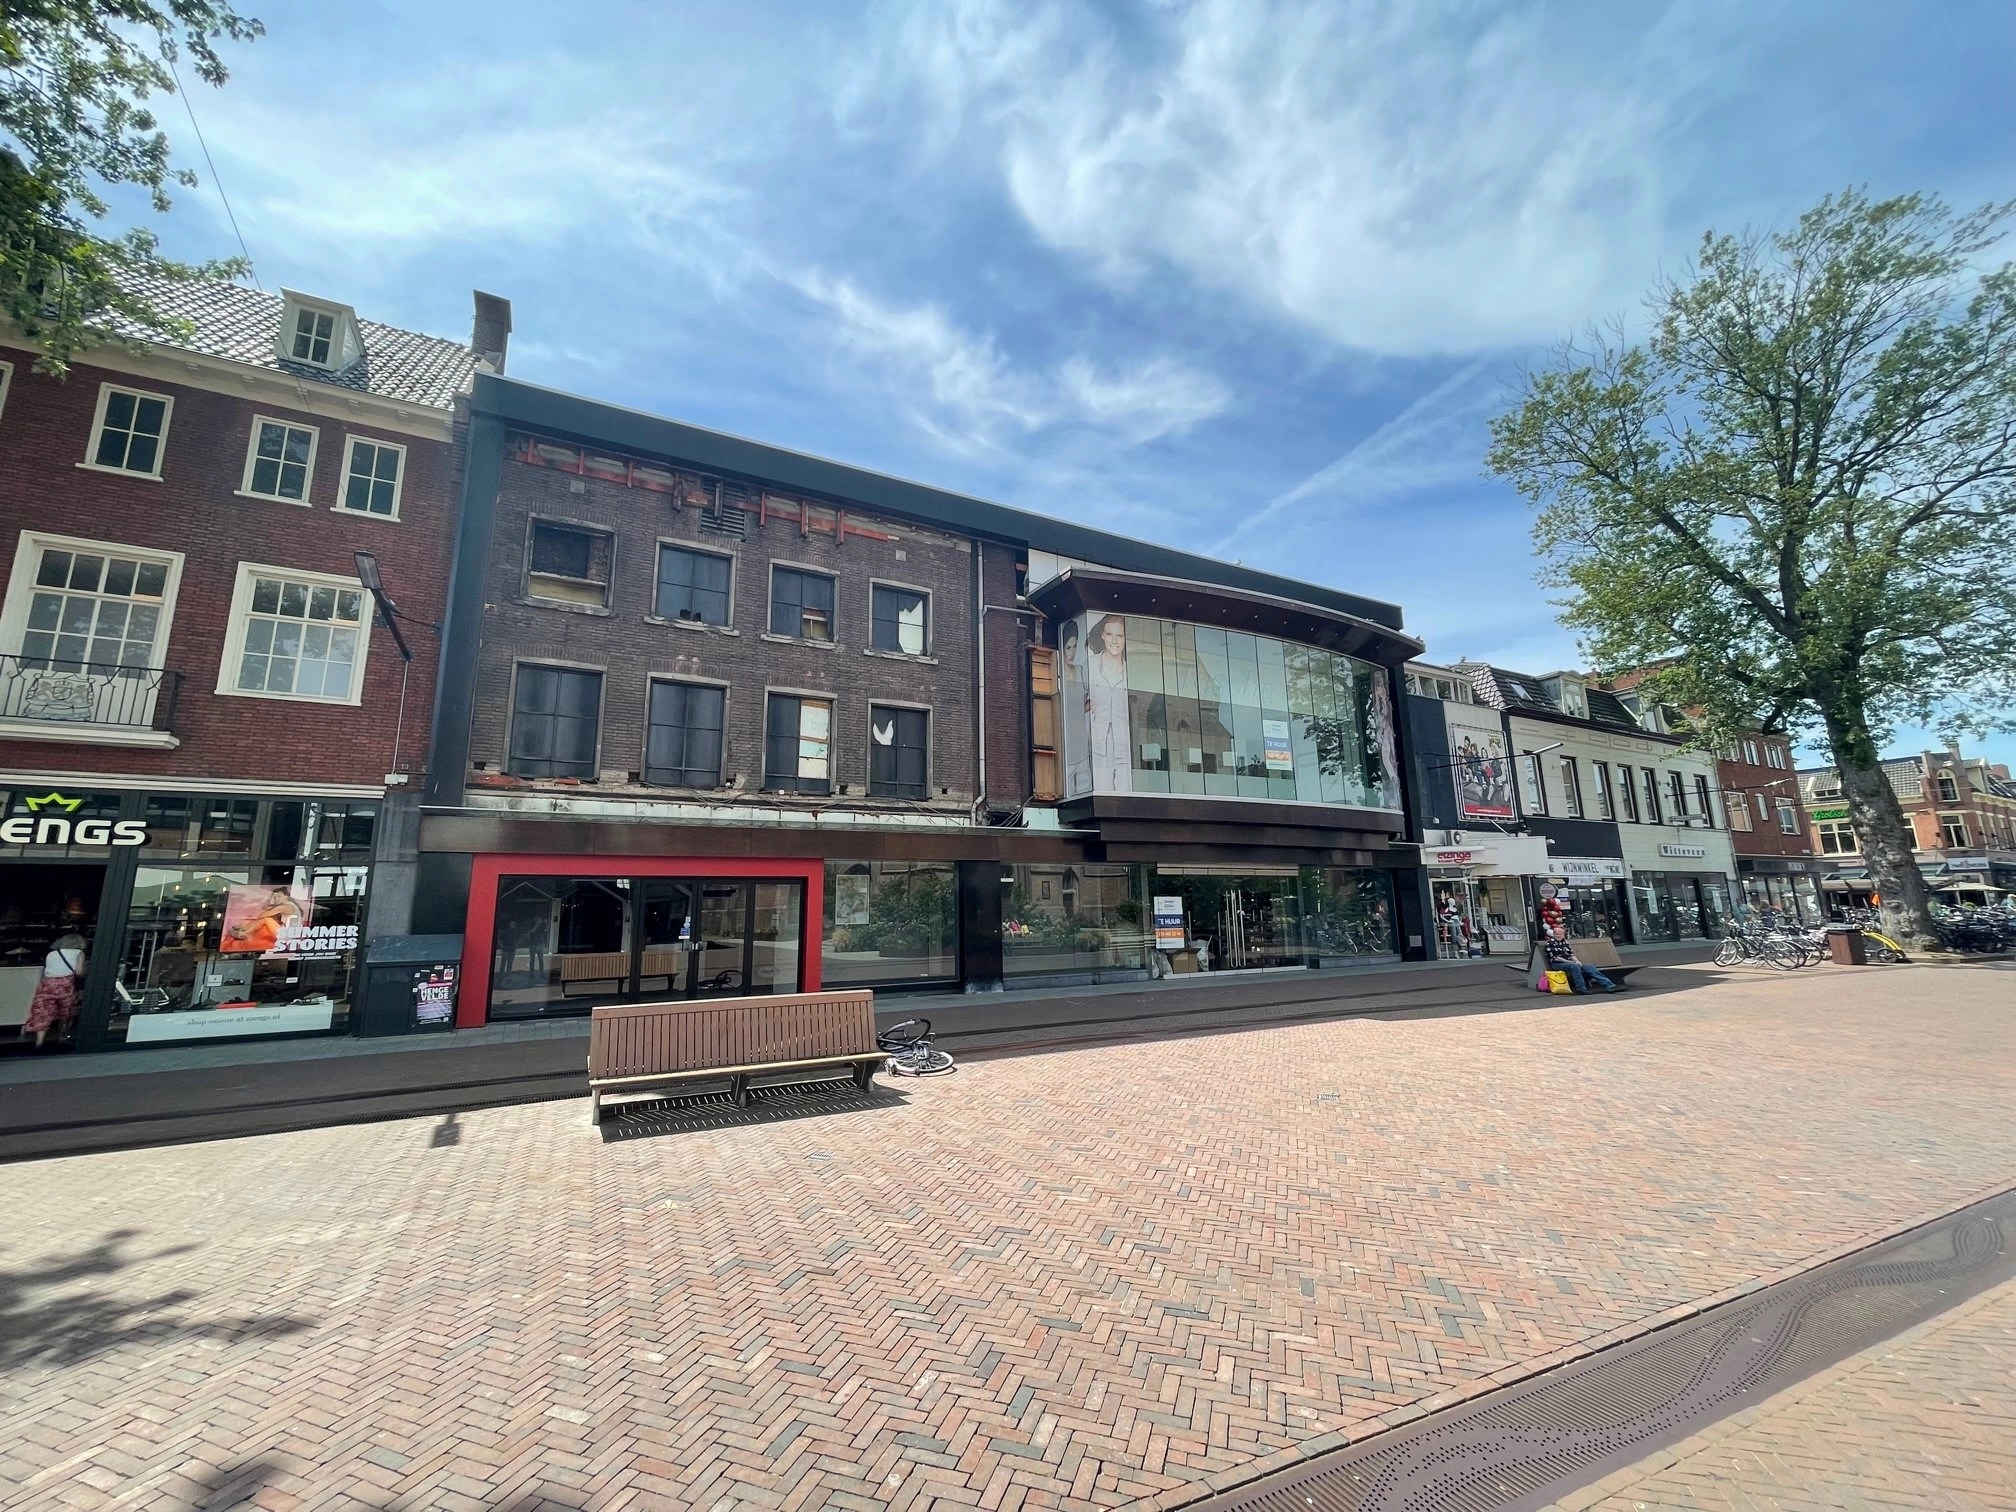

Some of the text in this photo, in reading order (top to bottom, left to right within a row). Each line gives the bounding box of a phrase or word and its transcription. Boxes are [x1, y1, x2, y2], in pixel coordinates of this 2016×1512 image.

[1662, 845, 1706, 856] Witteveen
[277, 925, 359, 939] SUMMER
[274, 937, 358, 952] STORIES
